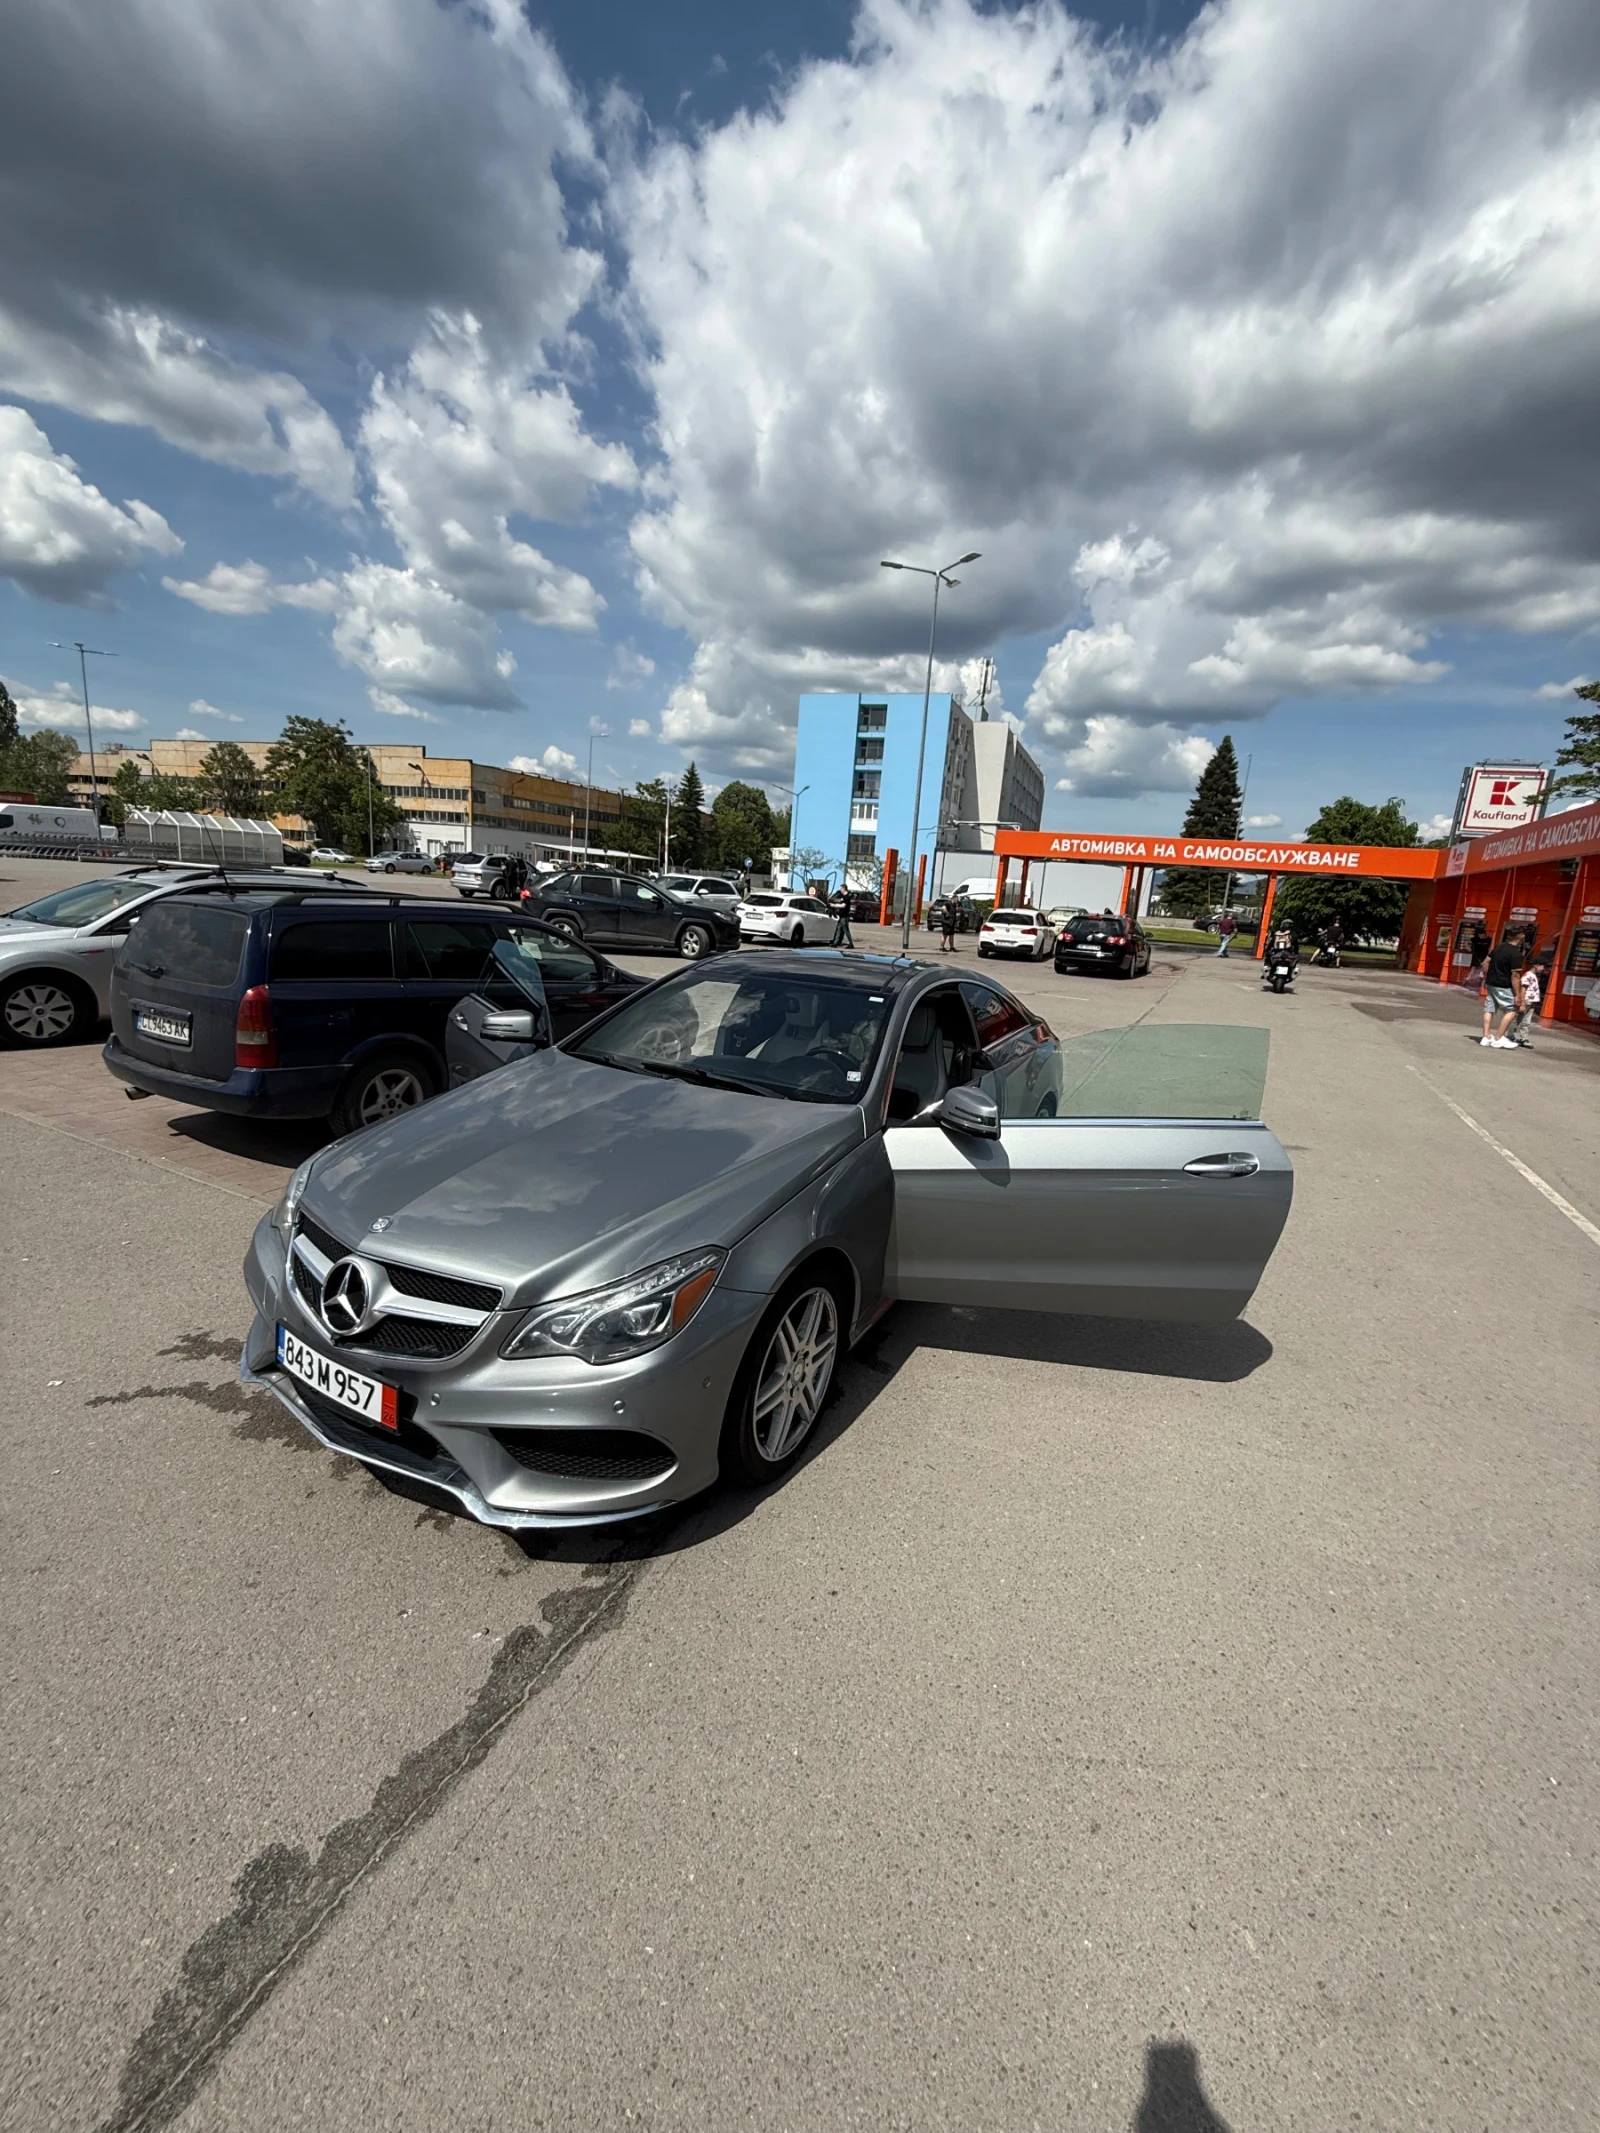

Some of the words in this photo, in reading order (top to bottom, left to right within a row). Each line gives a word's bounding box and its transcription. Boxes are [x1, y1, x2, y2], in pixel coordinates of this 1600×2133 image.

[1473, 810, 1527, 821] Kaufland
[1050, 838, 1147, 857] АВТОМИВКА
[1153, 843, 1177, 858] НА
[1183, 845, 1361, 868] САМООБСЛУЖВАНЕ
[1481, 835, 1524, 862] АВТОМИВКА
[1524, 831, 1536, 853] НА
[286, 1336, 314, 1380] 843
[318, 1357, 330, 1392] M
[334, 1369, 376, 1411] 957
